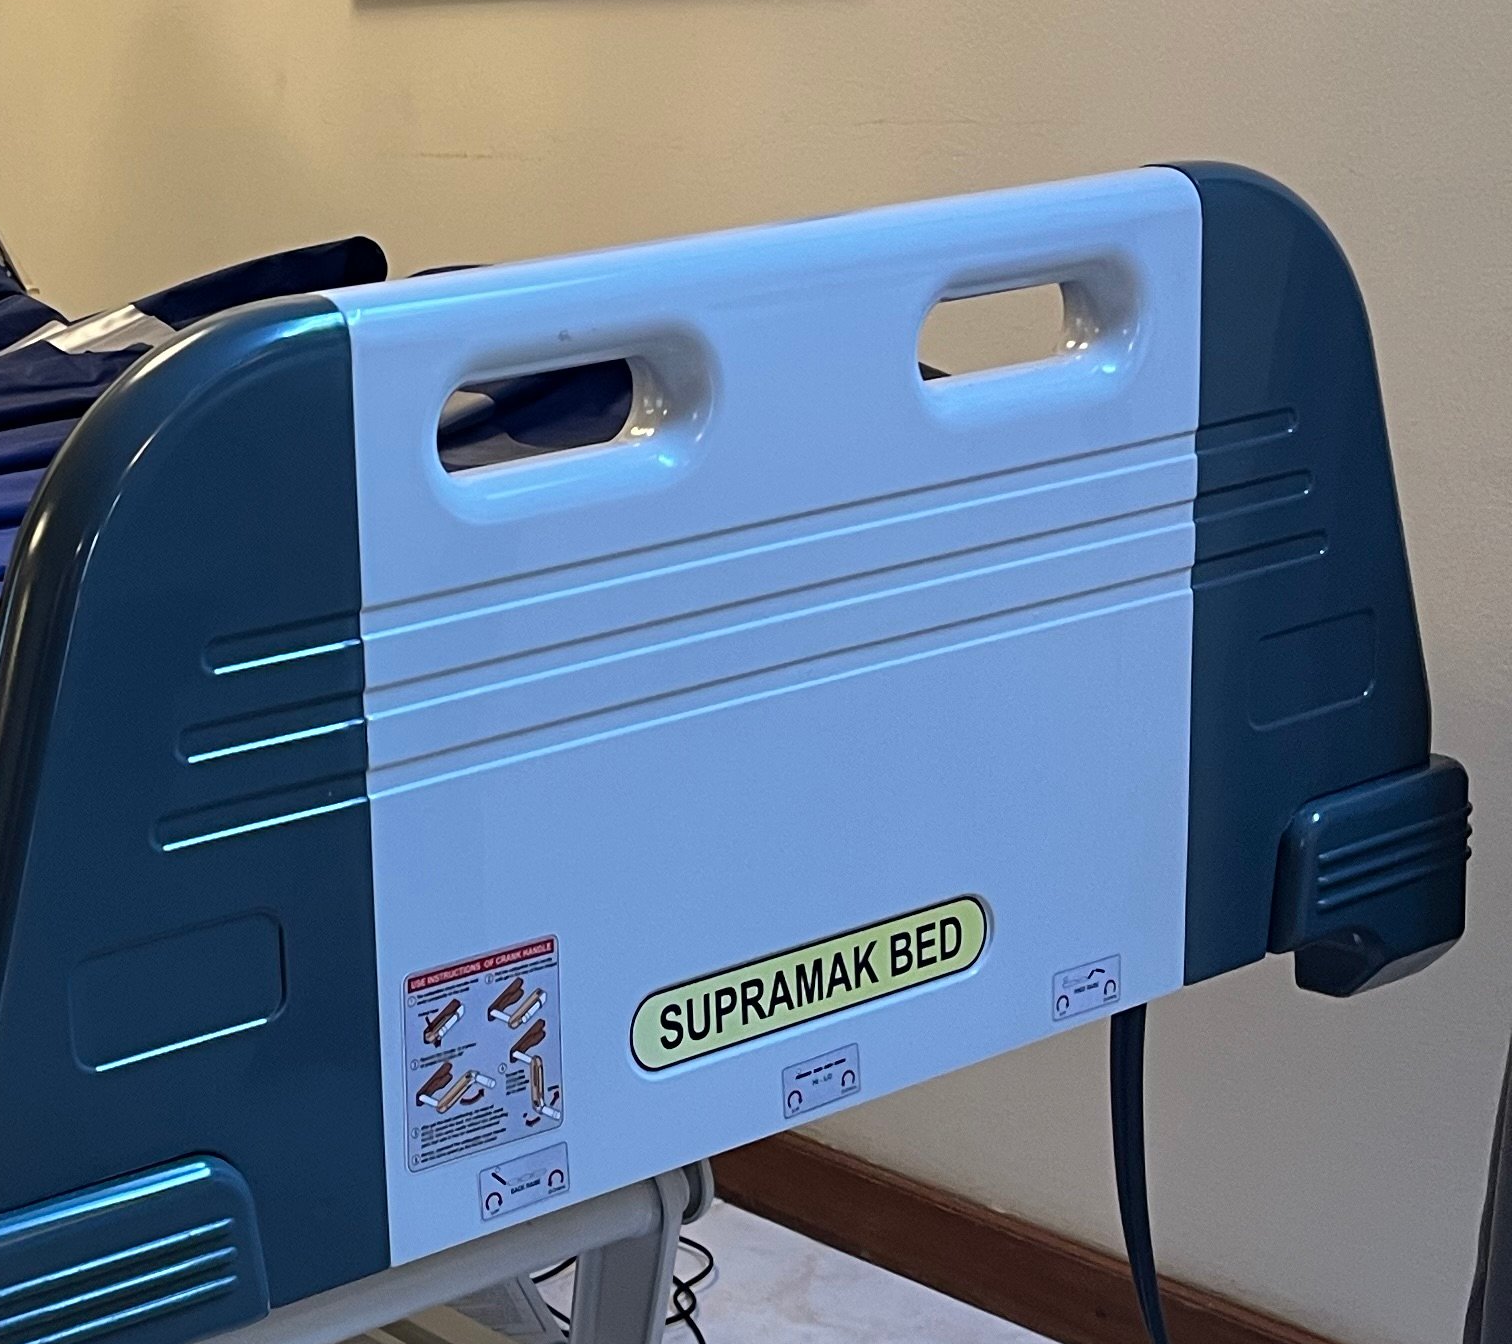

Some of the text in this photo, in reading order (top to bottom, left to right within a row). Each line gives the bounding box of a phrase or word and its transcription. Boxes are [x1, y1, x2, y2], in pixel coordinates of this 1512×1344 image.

[427, 962, 481, 985] INSTRUCTIONS
[483, 958, 494, 968] OF
[659, 916, 963, 1049] SUPRAMAK BED
